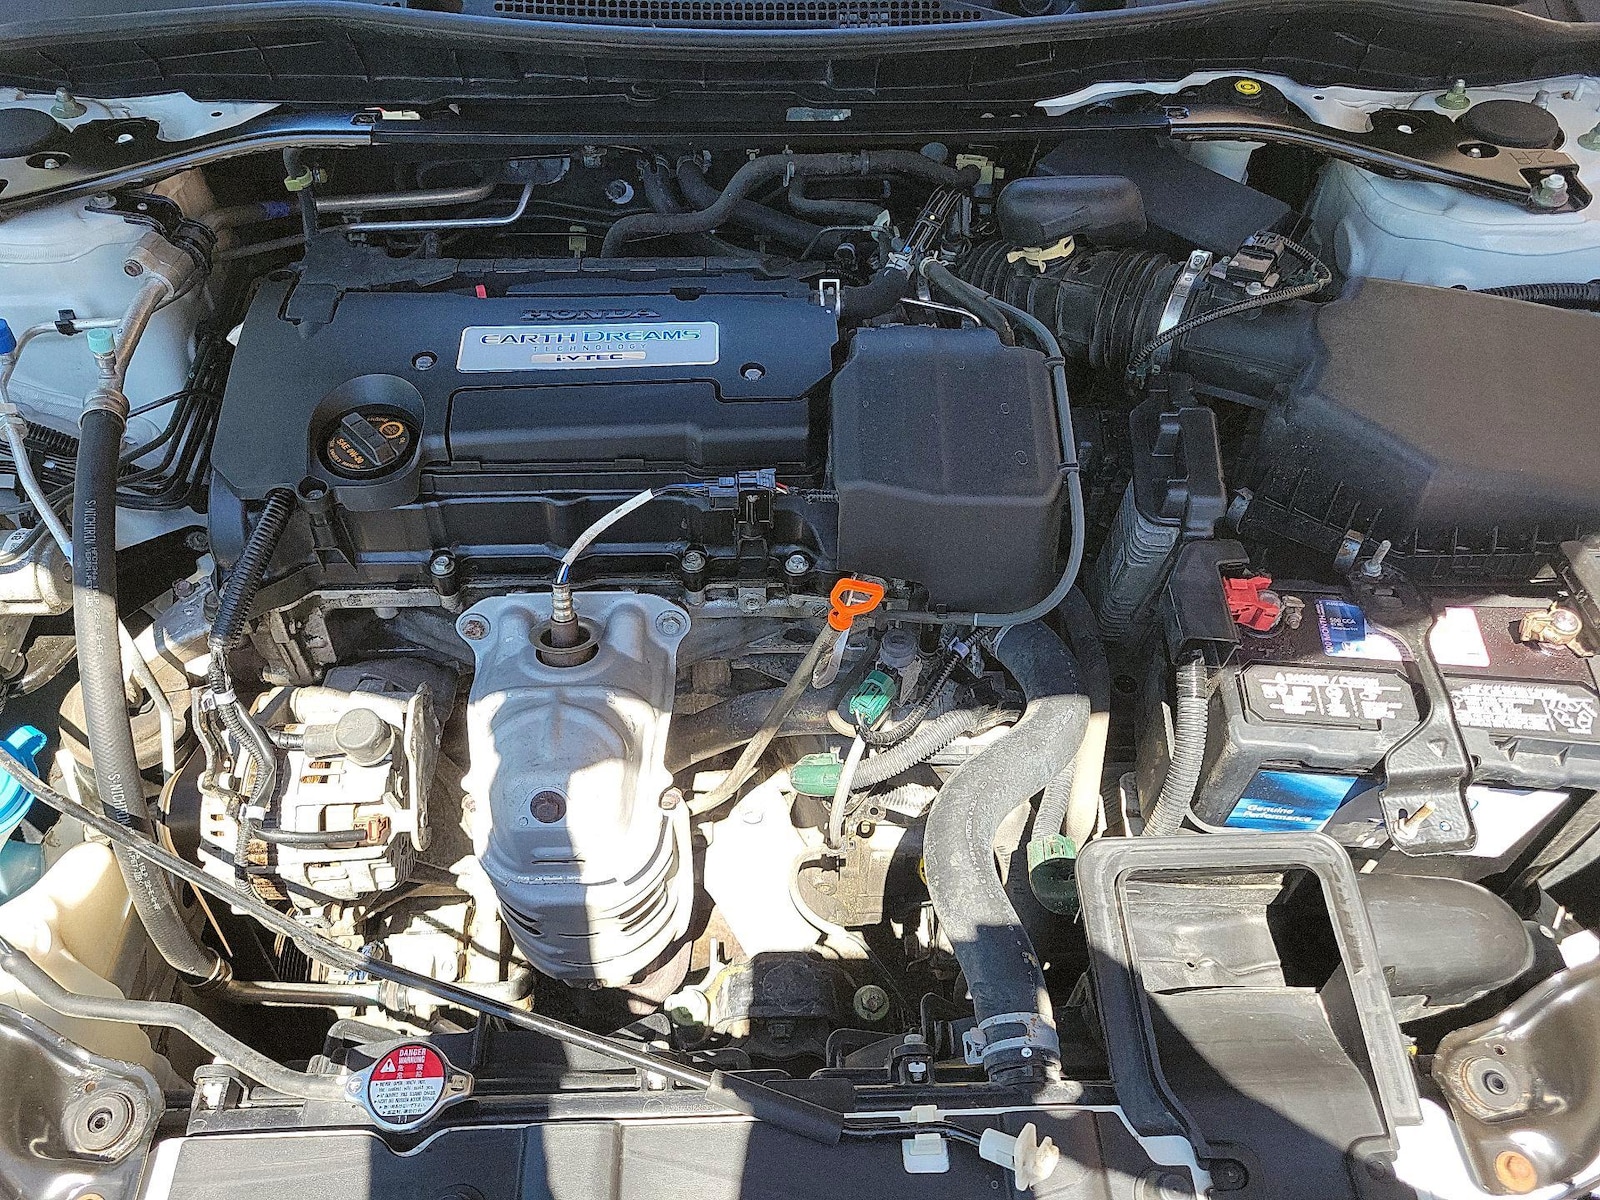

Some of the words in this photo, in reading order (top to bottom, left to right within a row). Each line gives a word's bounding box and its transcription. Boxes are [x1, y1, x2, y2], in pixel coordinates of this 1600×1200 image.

[519, 308, 660, 321] HONDA
[480, 332, 577, 345] EARTH
[582, 329, 702, 343] DREAMS
[532, 343, 647, 353] TECHNOLOGY
[336, 438, 350, 451] SAE
[1246, 804, 1295, 815] Genuine
[1242, 810, 1313, 823] Performance
[399, 1047, 427, 1057] DANGER
